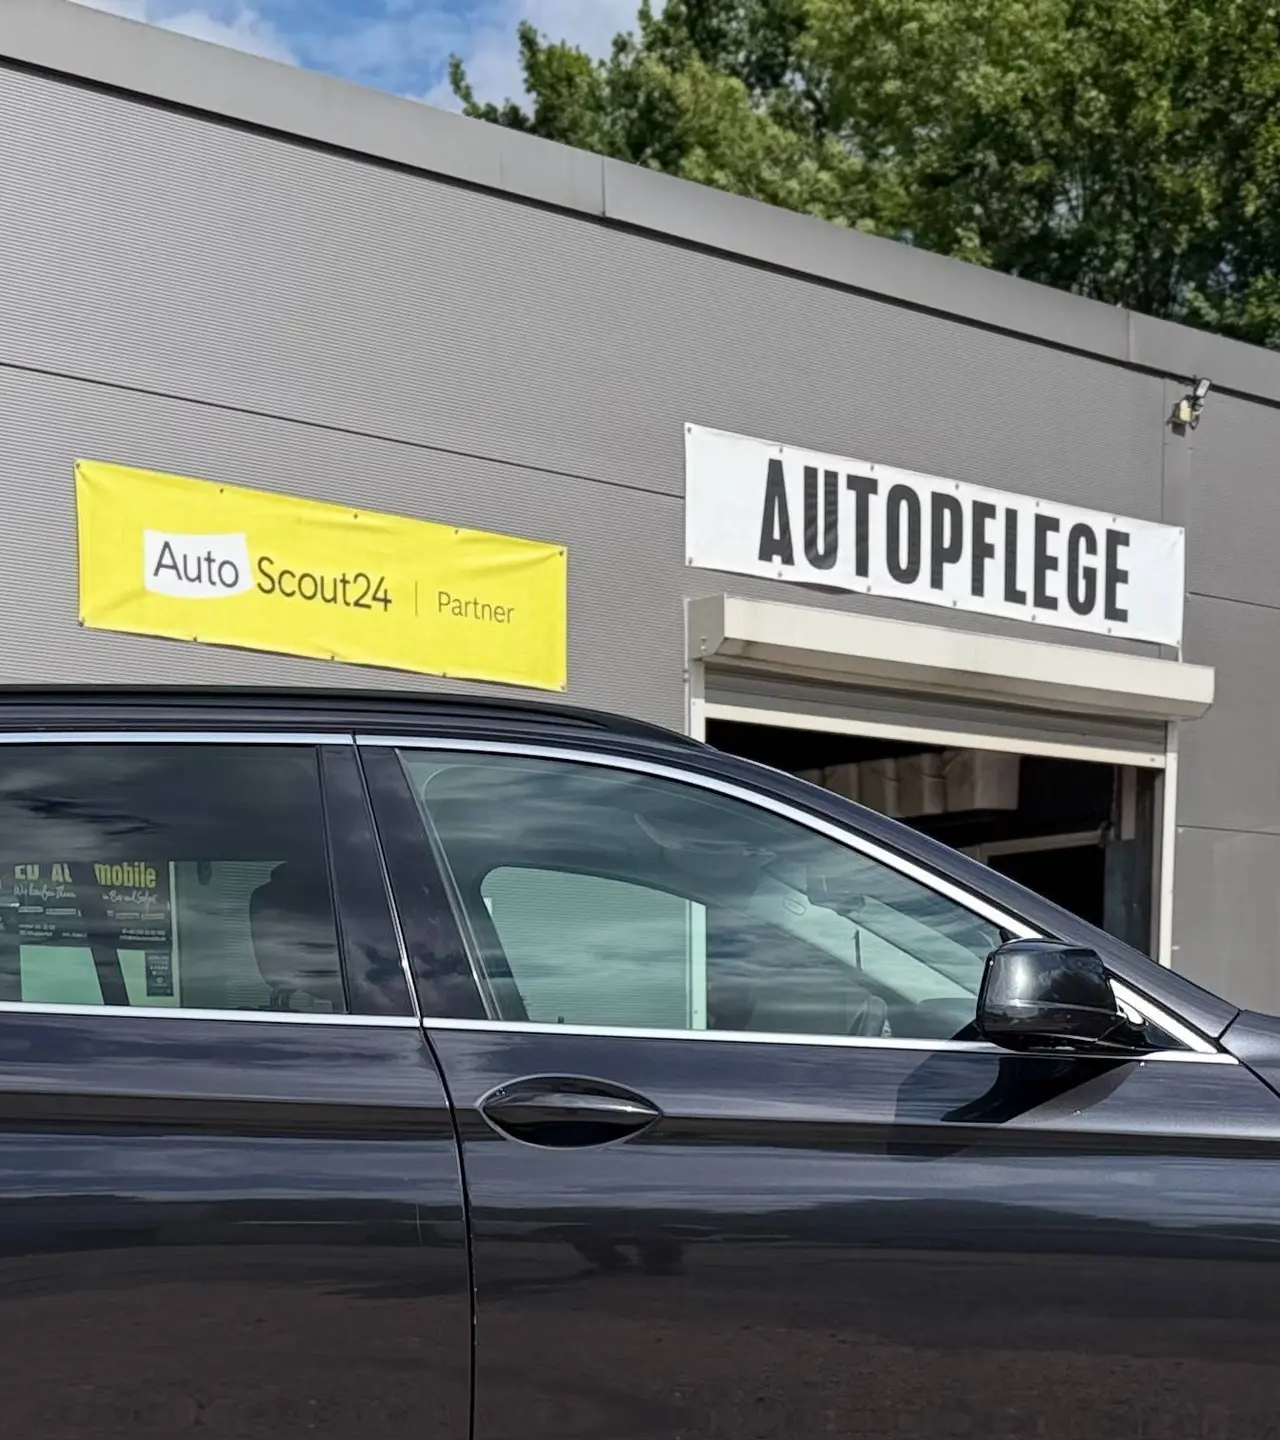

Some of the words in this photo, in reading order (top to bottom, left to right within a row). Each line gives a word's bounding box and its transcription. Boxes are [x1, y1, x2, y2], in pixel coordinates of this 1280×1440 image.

[153, 541, 240, 588] Auto
[256, 556, 393, 612] Scout24
[437, 591, 515, 624] Partner
[758, 458, 1130, 623] AUTOPFLEGE
